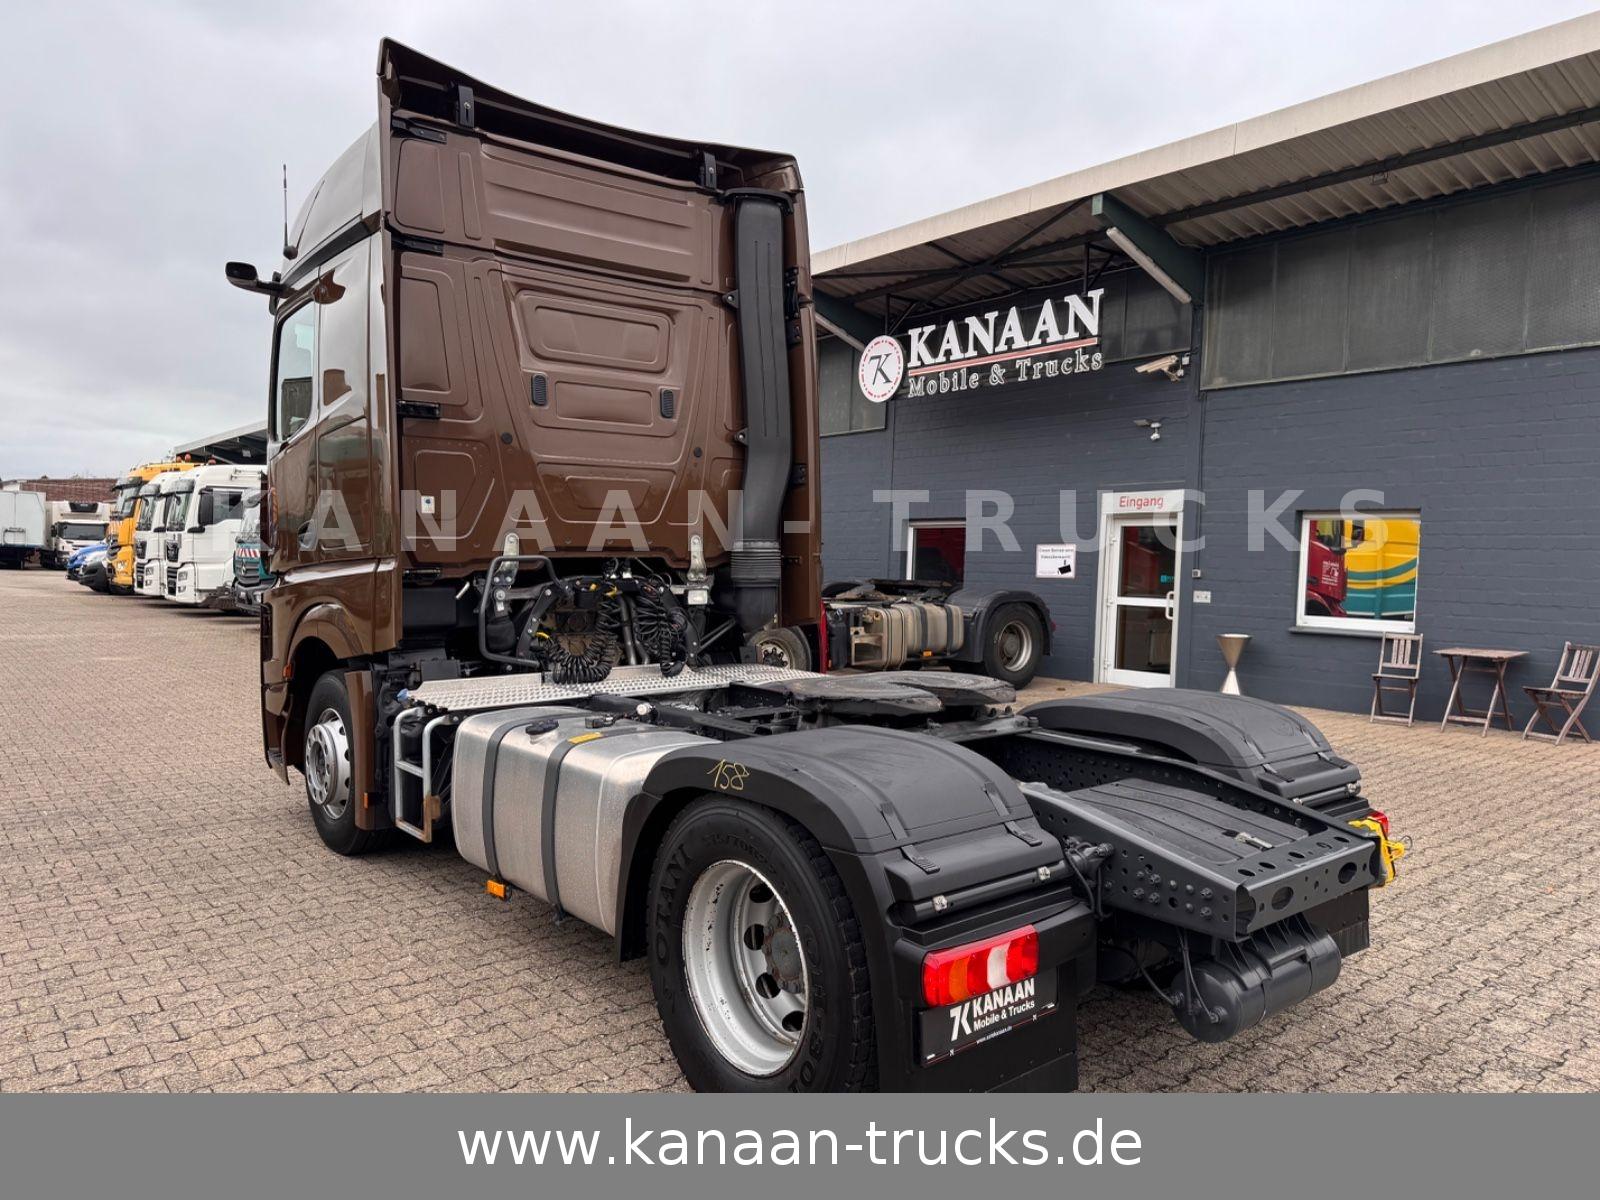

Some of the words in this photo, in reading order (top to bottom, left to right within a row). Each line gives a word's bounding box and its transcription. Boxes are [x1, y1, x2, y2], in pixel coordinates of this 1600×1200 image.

[907, 288, 1105, 367] KANAAN
[907, 366, 979, 398] Mobile
[989, 363, 1005, 385] &
[1015, 348, 1103, 382] Trucks
[1119, 495, 1164, 510] Eingang
[706, 758, 750, 791] 158
[973, 978, 1035, 1018] KANAAN
[973, 1013, 1000, 1032] Mobile
[1001, 1009, 1008, 1020] &
[1009, 1000, 1035, 1018] Trucks
